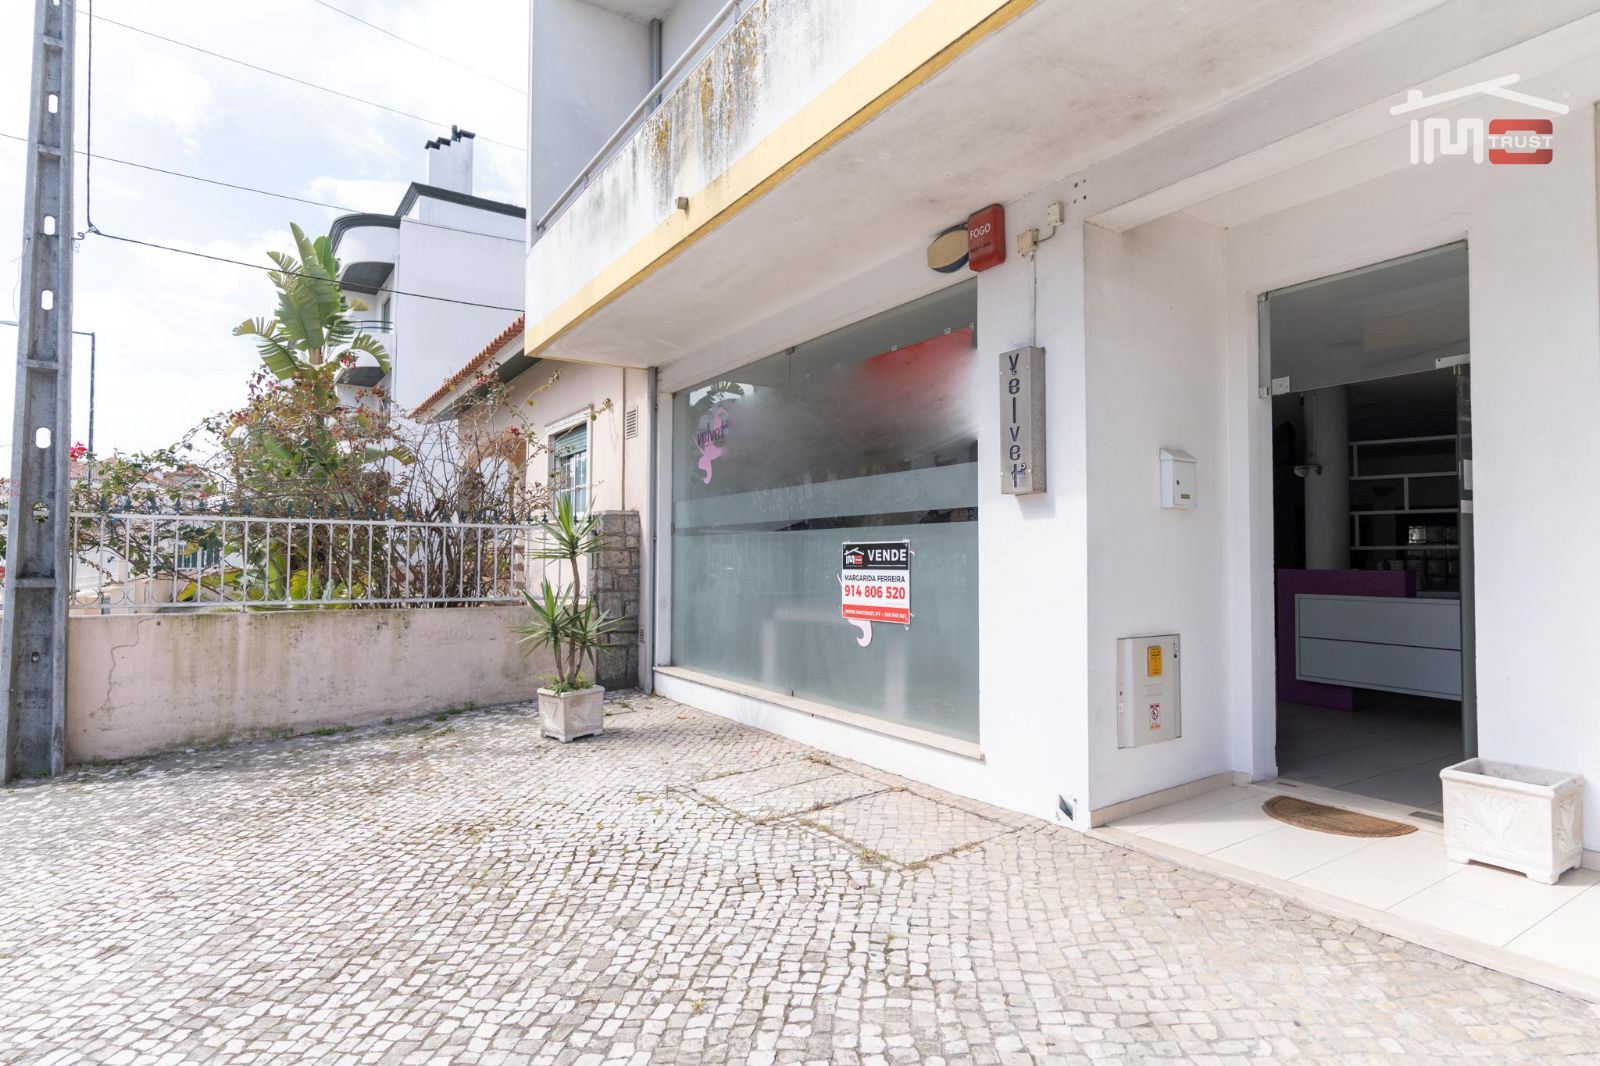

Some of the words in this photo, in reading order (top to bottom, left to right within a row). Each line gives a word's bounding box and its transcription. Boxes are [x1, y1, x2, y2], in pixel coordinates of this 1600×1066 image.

[970, 223, 991, 240] FOGO
[1008, 353, 1027, 488] velvet
[867, 549, 907, 562] VENDE
[844, 574, 876, 582] MARGARIDA
[877, 575, 905, 583] FERREIRA
[844, 585, 862, 597] 914
[864, 585, 883, 598] 806
[886, 586, 905, 600] 520
